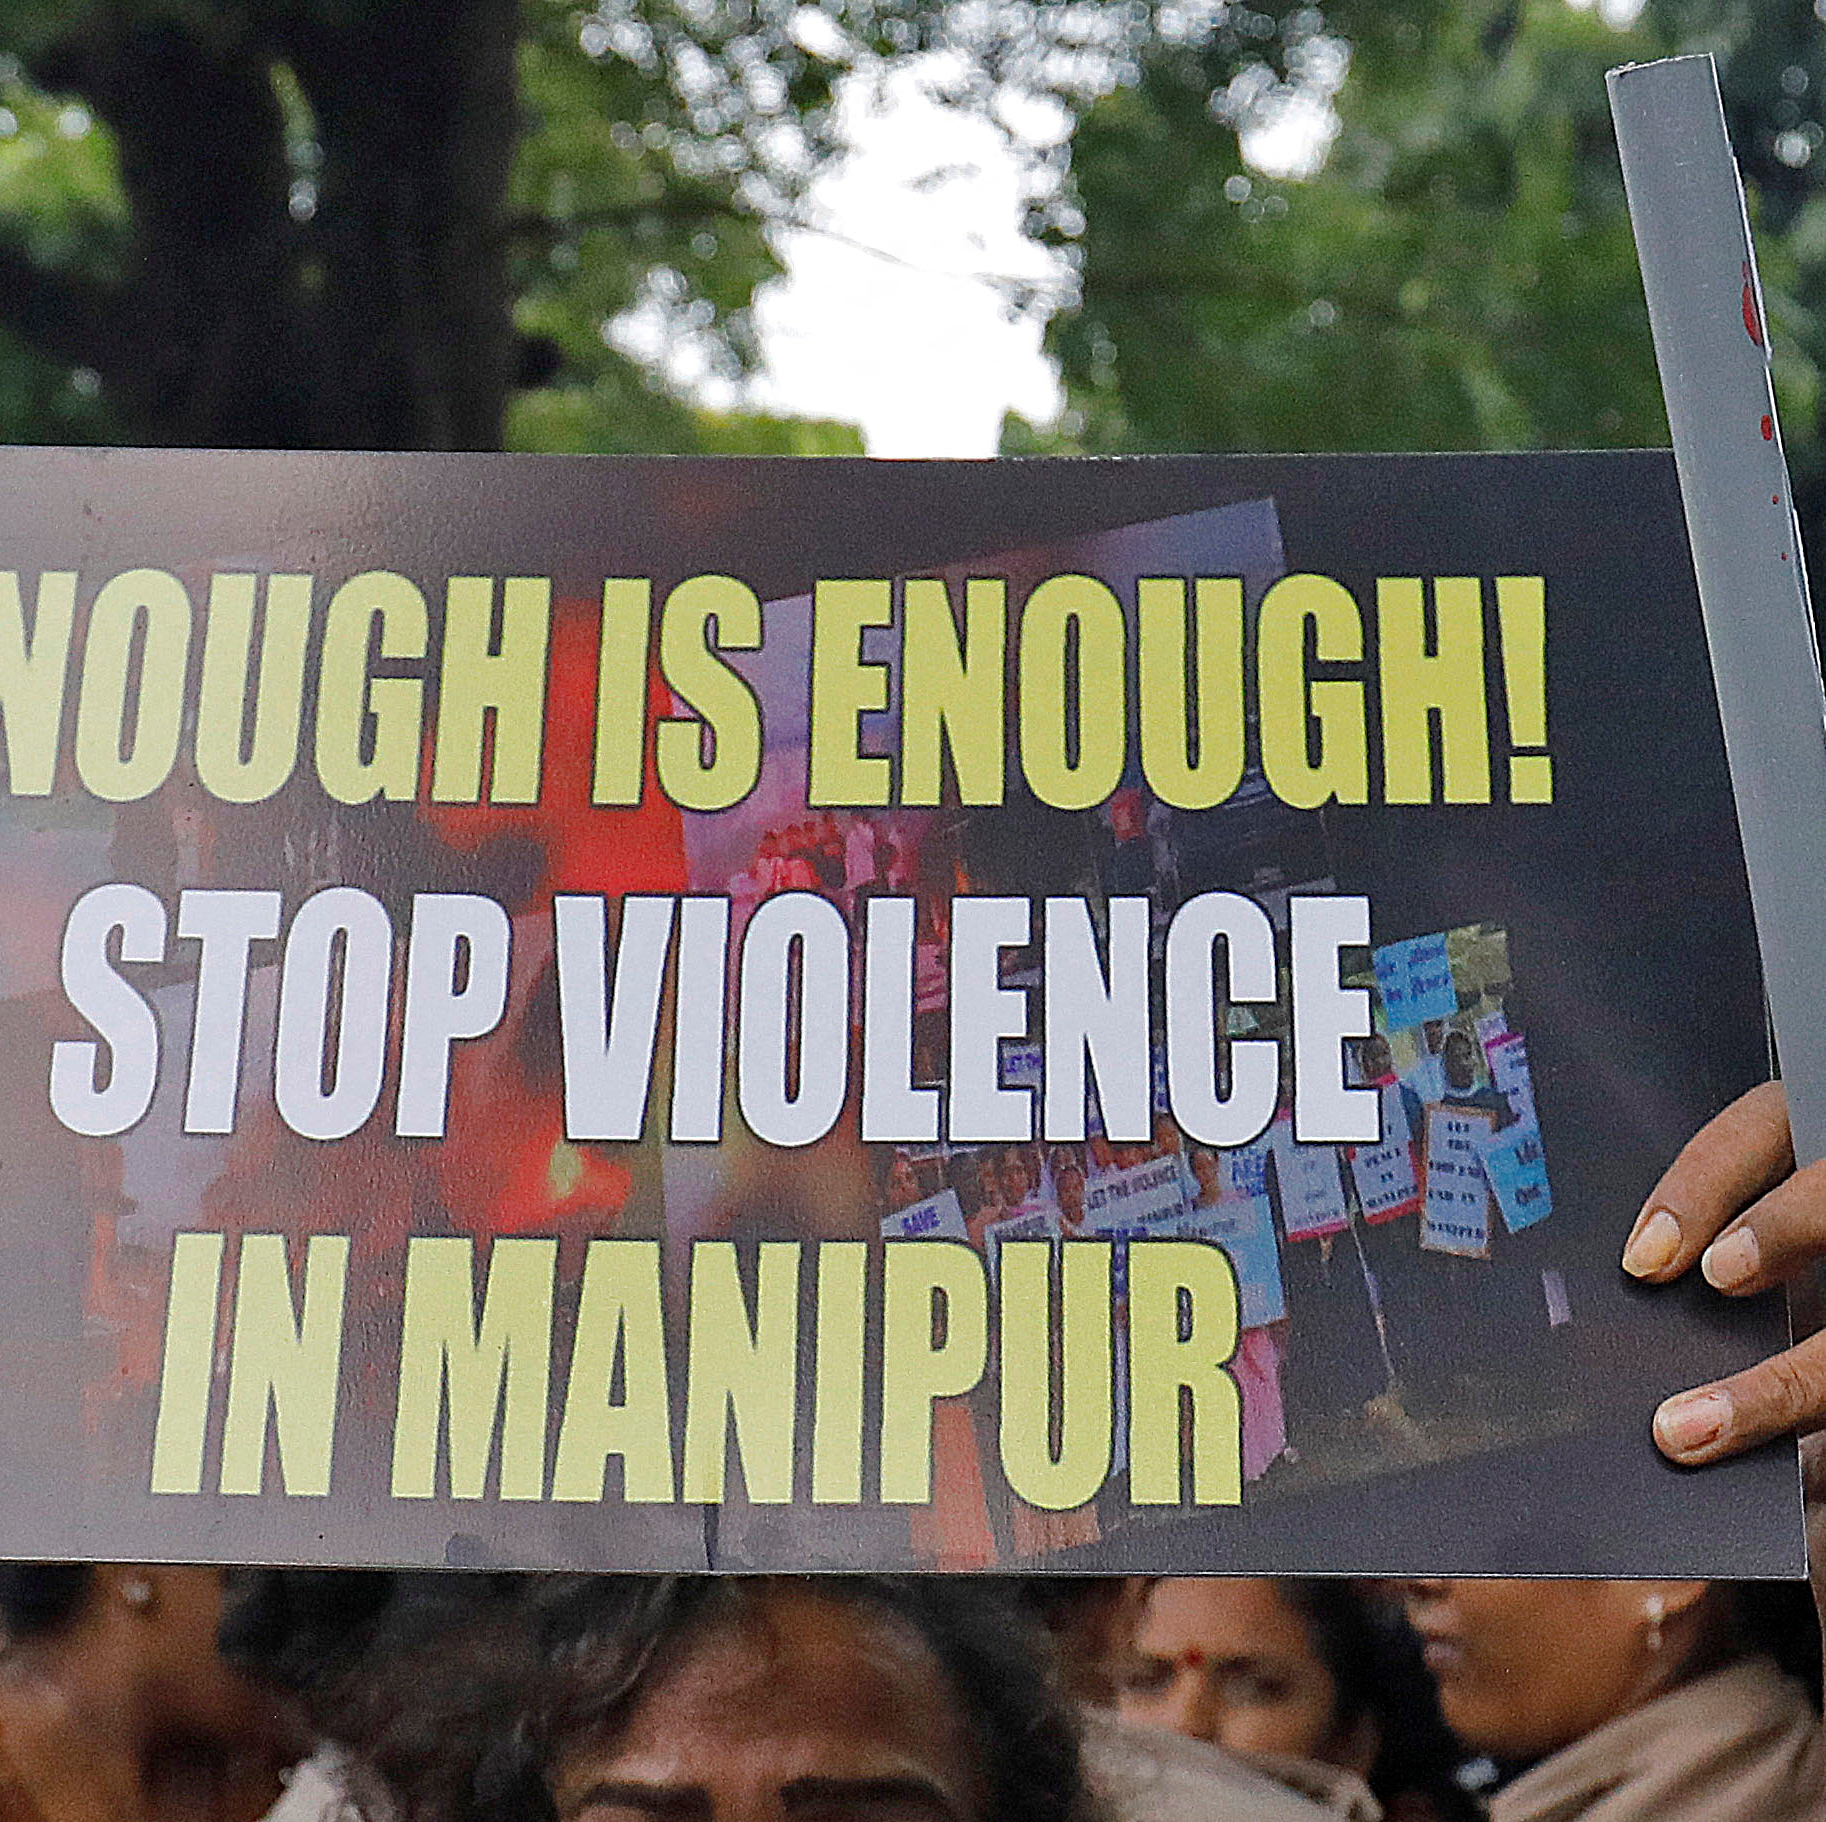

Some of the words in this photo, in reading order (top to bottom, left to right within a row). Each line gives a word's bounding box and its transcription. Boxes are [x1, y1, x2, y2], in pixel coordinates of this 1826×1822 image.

[590, 573, 763, 813] IS
[806, 573, 1556, 812] ENOUGH!
[47, 880, 512, 1142] STOP
[552, 890, 1382, 1149] VIOLENCE
[149, 1232, 351, 1499] IN
[388, 1235, 1245, 1513] MANIPUR
